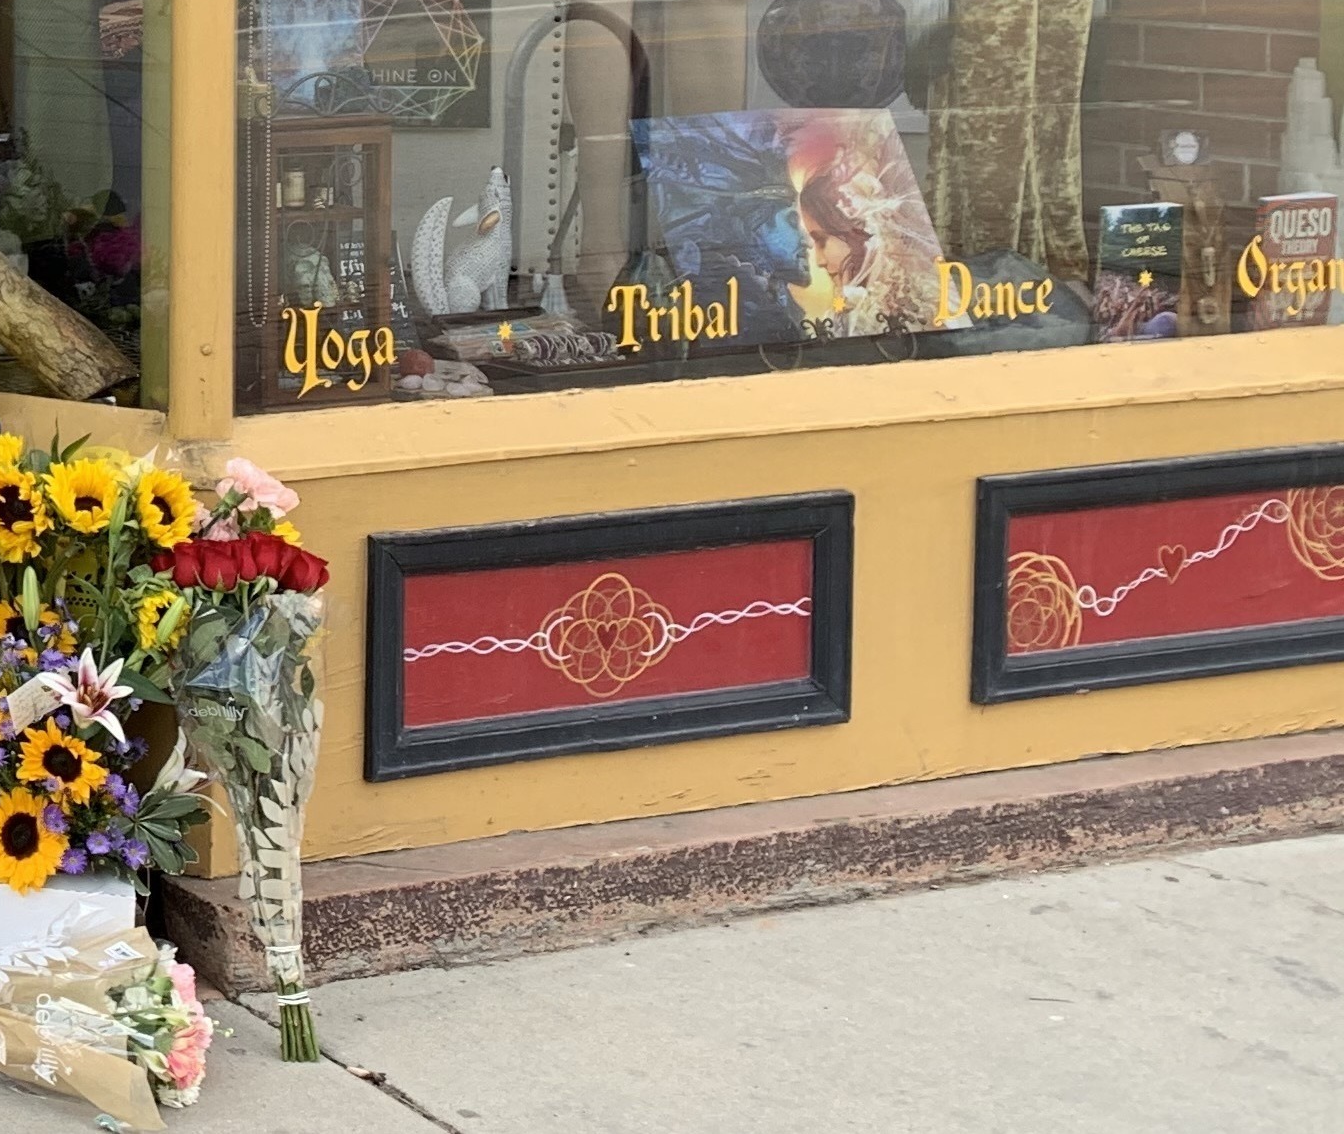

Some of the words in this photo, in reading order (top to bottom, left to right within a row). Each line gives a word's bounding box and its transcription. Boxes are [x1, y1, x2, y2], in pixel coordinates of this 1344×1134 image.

[371, 68, 417, 83] HINE
[428, 68, 457, 83] ON
[1270, 207, 1332, 244] QUESO
[607, 276, 740, 352] Tribal
[933, 256, 1054, 327] Dance
[281, 301, 398, 400] Yoga
